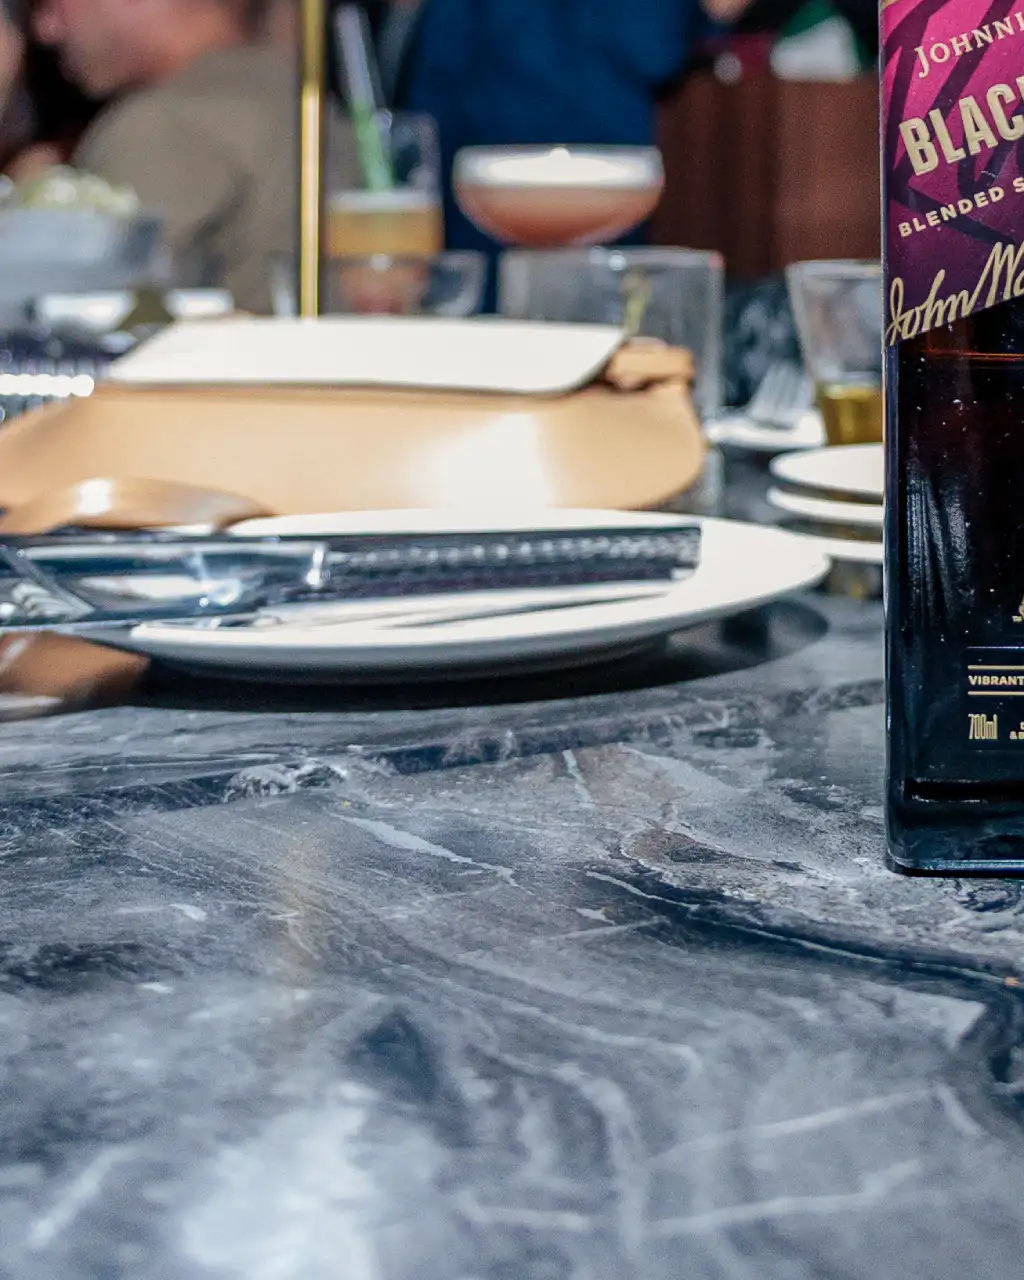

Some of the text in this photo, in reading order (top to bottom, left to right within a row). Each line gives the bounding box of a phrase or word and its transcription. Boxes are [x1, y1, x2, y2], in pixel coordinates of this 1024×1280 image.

[899, 186, 1005, 238] BLENDED
[885, 269, 972, 346] John
[968, 713, 998, 740] 700ml
